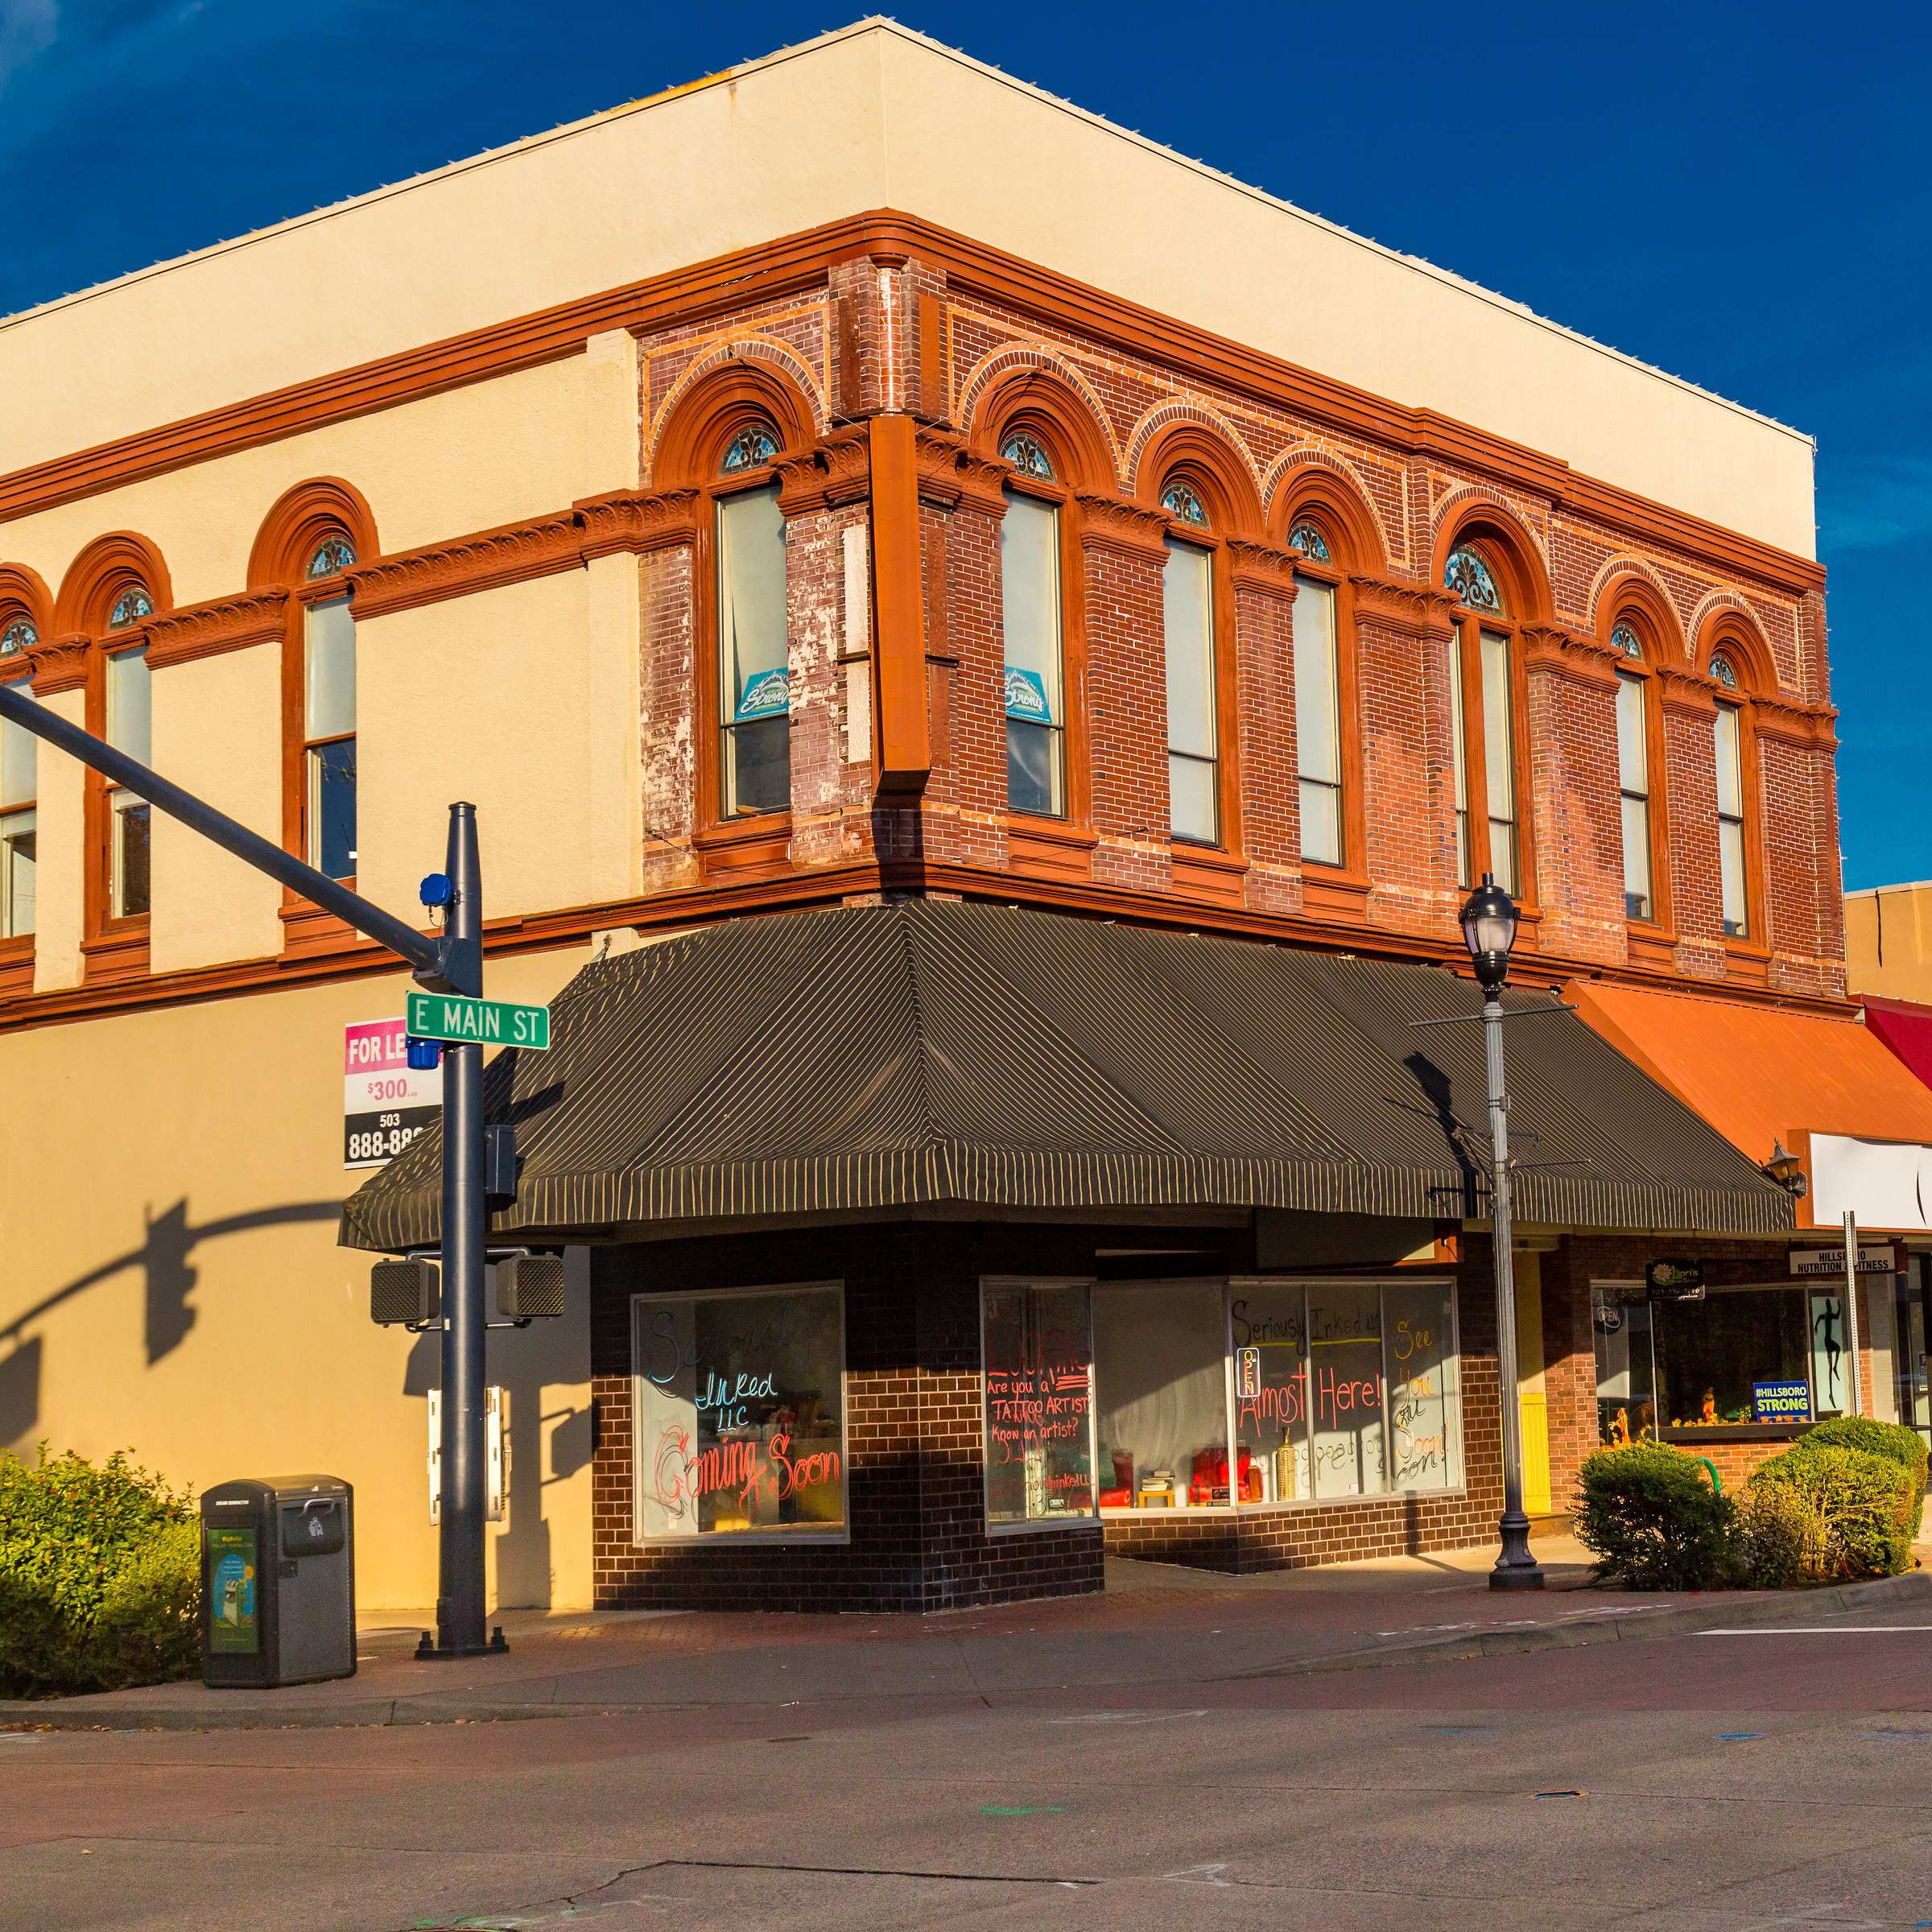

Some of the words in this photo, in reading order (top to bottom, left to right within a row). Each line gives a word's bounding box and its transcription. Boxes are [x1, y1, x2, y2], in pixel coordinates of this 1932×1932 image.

[415, 999, 429, 1030] E
[444, 1002, 500, 1038] MAIN
[514, 1010, 539, 1042] ST
[349, 1036, 382, 1064] FOR
[386, 1033, 407, 1060] LE
[367, 1078, 407, 1100] $300
[379, 1113, 400, 1127] 503
[1798, 1261, 1842, 1273] NUTRITION
[1818, 1250, 1866, 1262] HILLSBO
[1394, 1318, 1433, 1360] See
[1244, 1350, 1254, 1395] OPEN
[987, 1380, 1008, 1394] Are
[1011, 1381, 1034, 1401] you
[1040, 1381, 1050, 1393] a
[1319, 1367, 1381, 1430] Here!
[1756, 1386, 1807, 1397] #HILLSBORO
[991, 1399, 1043, 1420] TATTOO
[1757, 1397, 1808, 1412] STRONG
[992, 1424, 1019, 1443] Know
[1040, 1417, 1079, 1439] artist?
[654, 1425, 767, 1517] Coming
[768, 1433, 840, 1500] Soon
